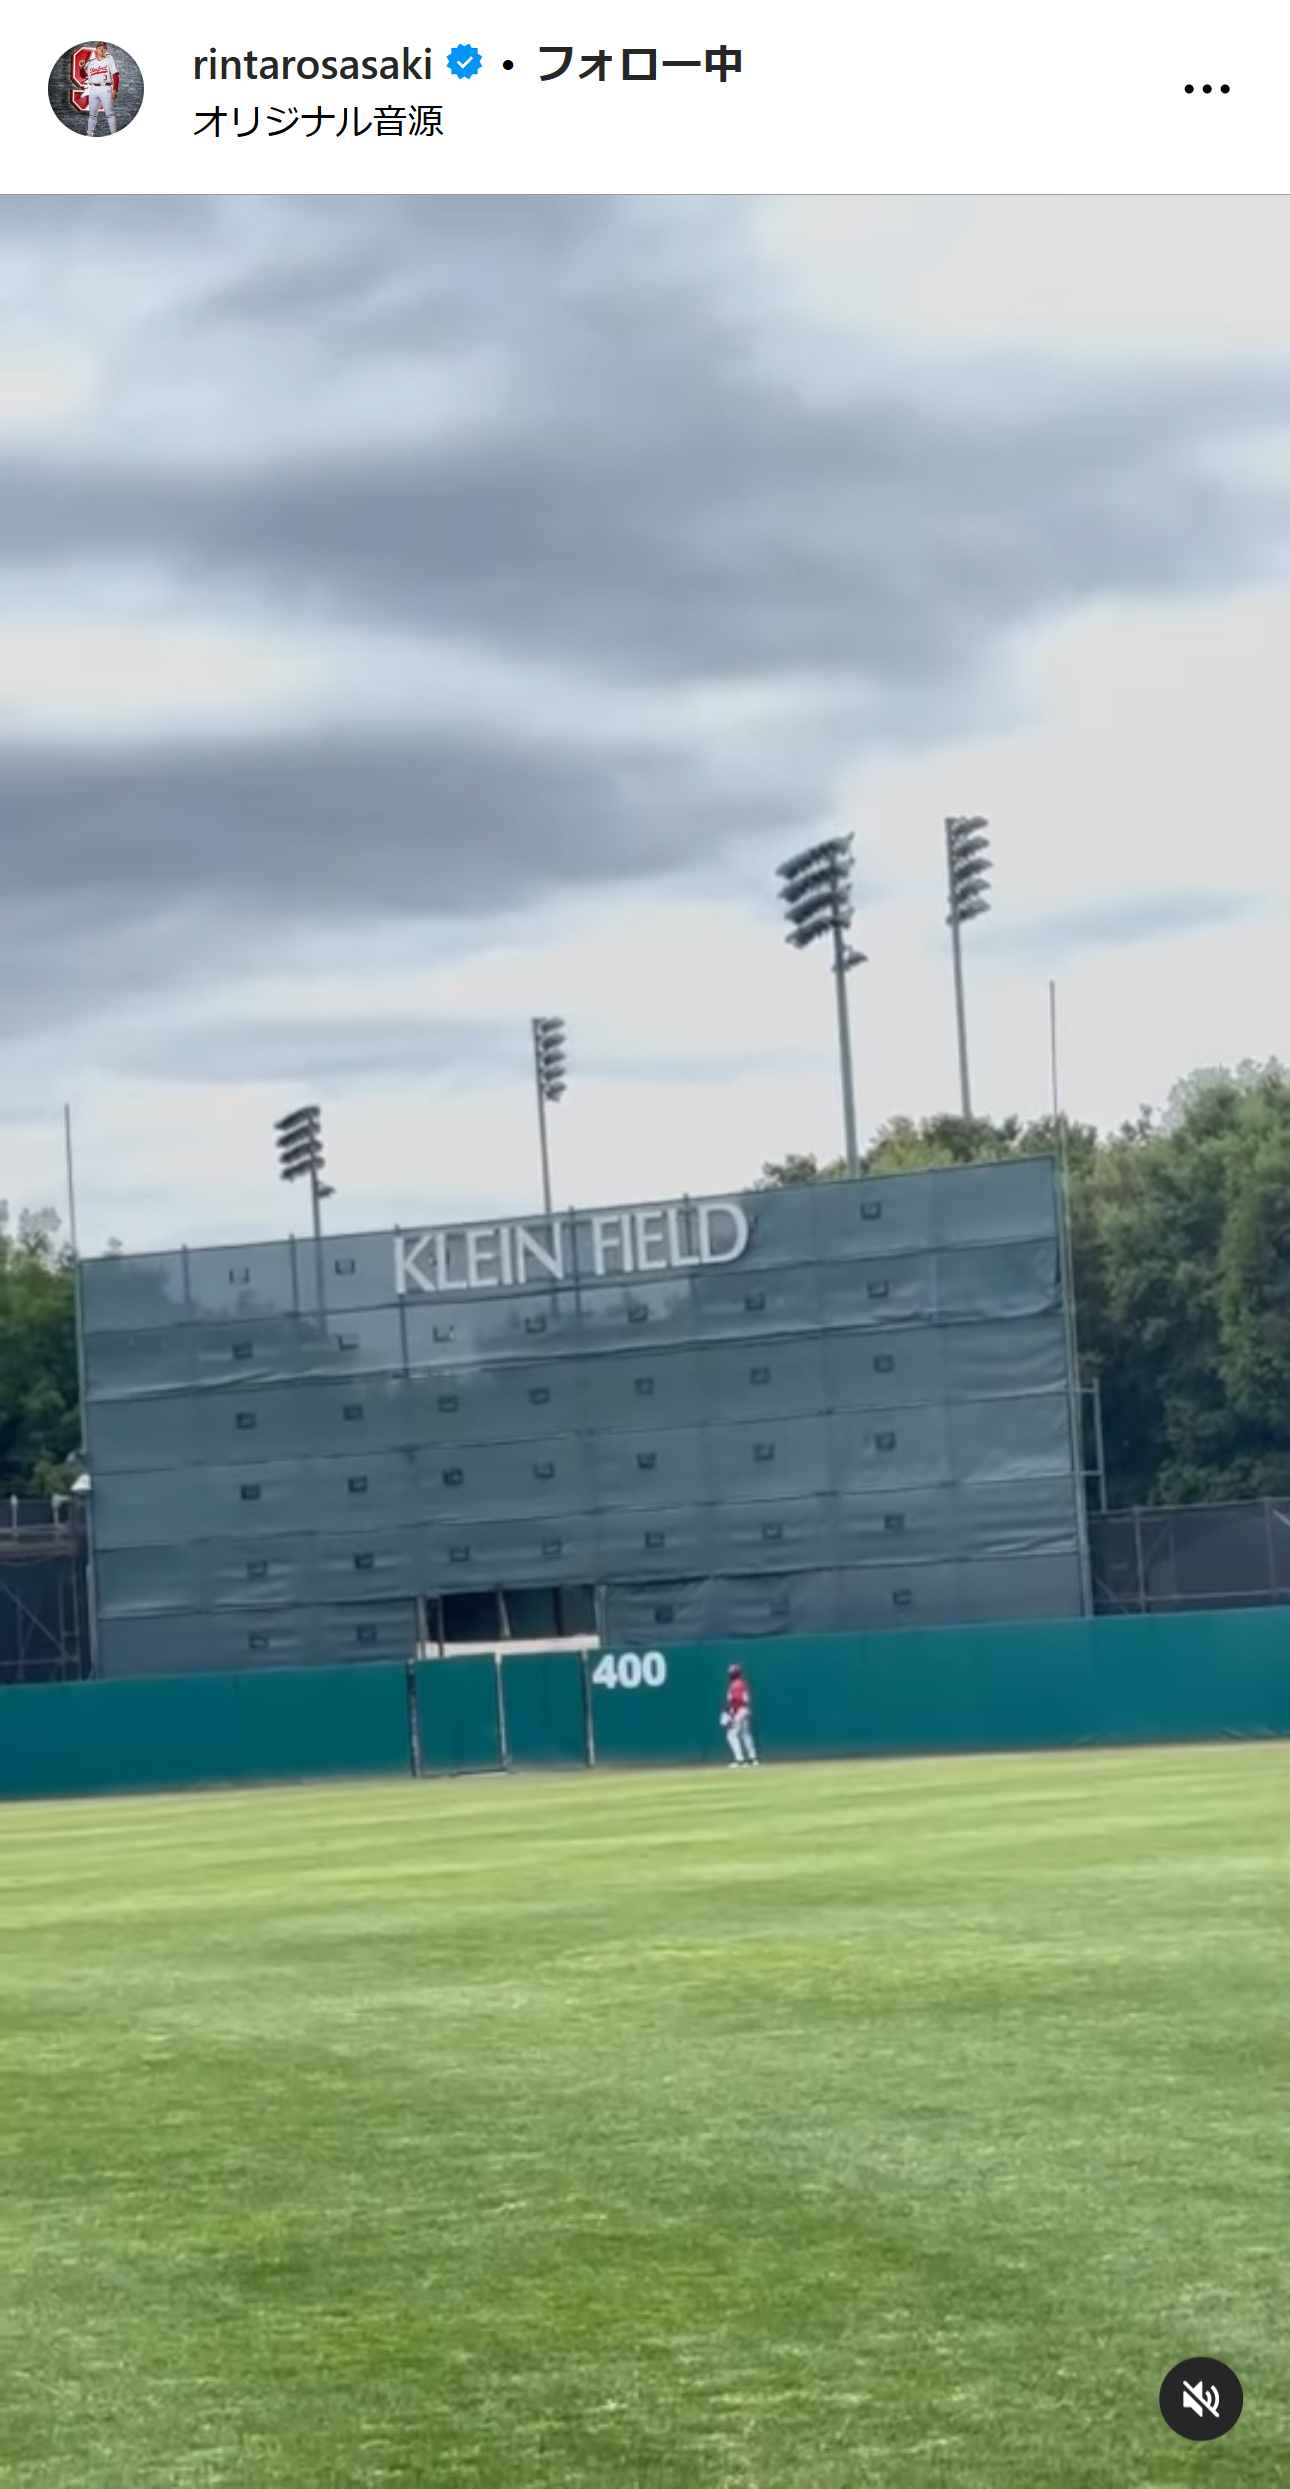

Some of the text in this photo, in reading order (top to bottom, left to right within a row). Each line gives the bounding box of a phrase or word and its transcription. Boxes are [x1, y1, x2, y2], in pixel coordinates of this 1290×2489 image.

[394, 1202, 749, 1294] KLEIN FIELD
[592, 1651, 667, 1689] 400
